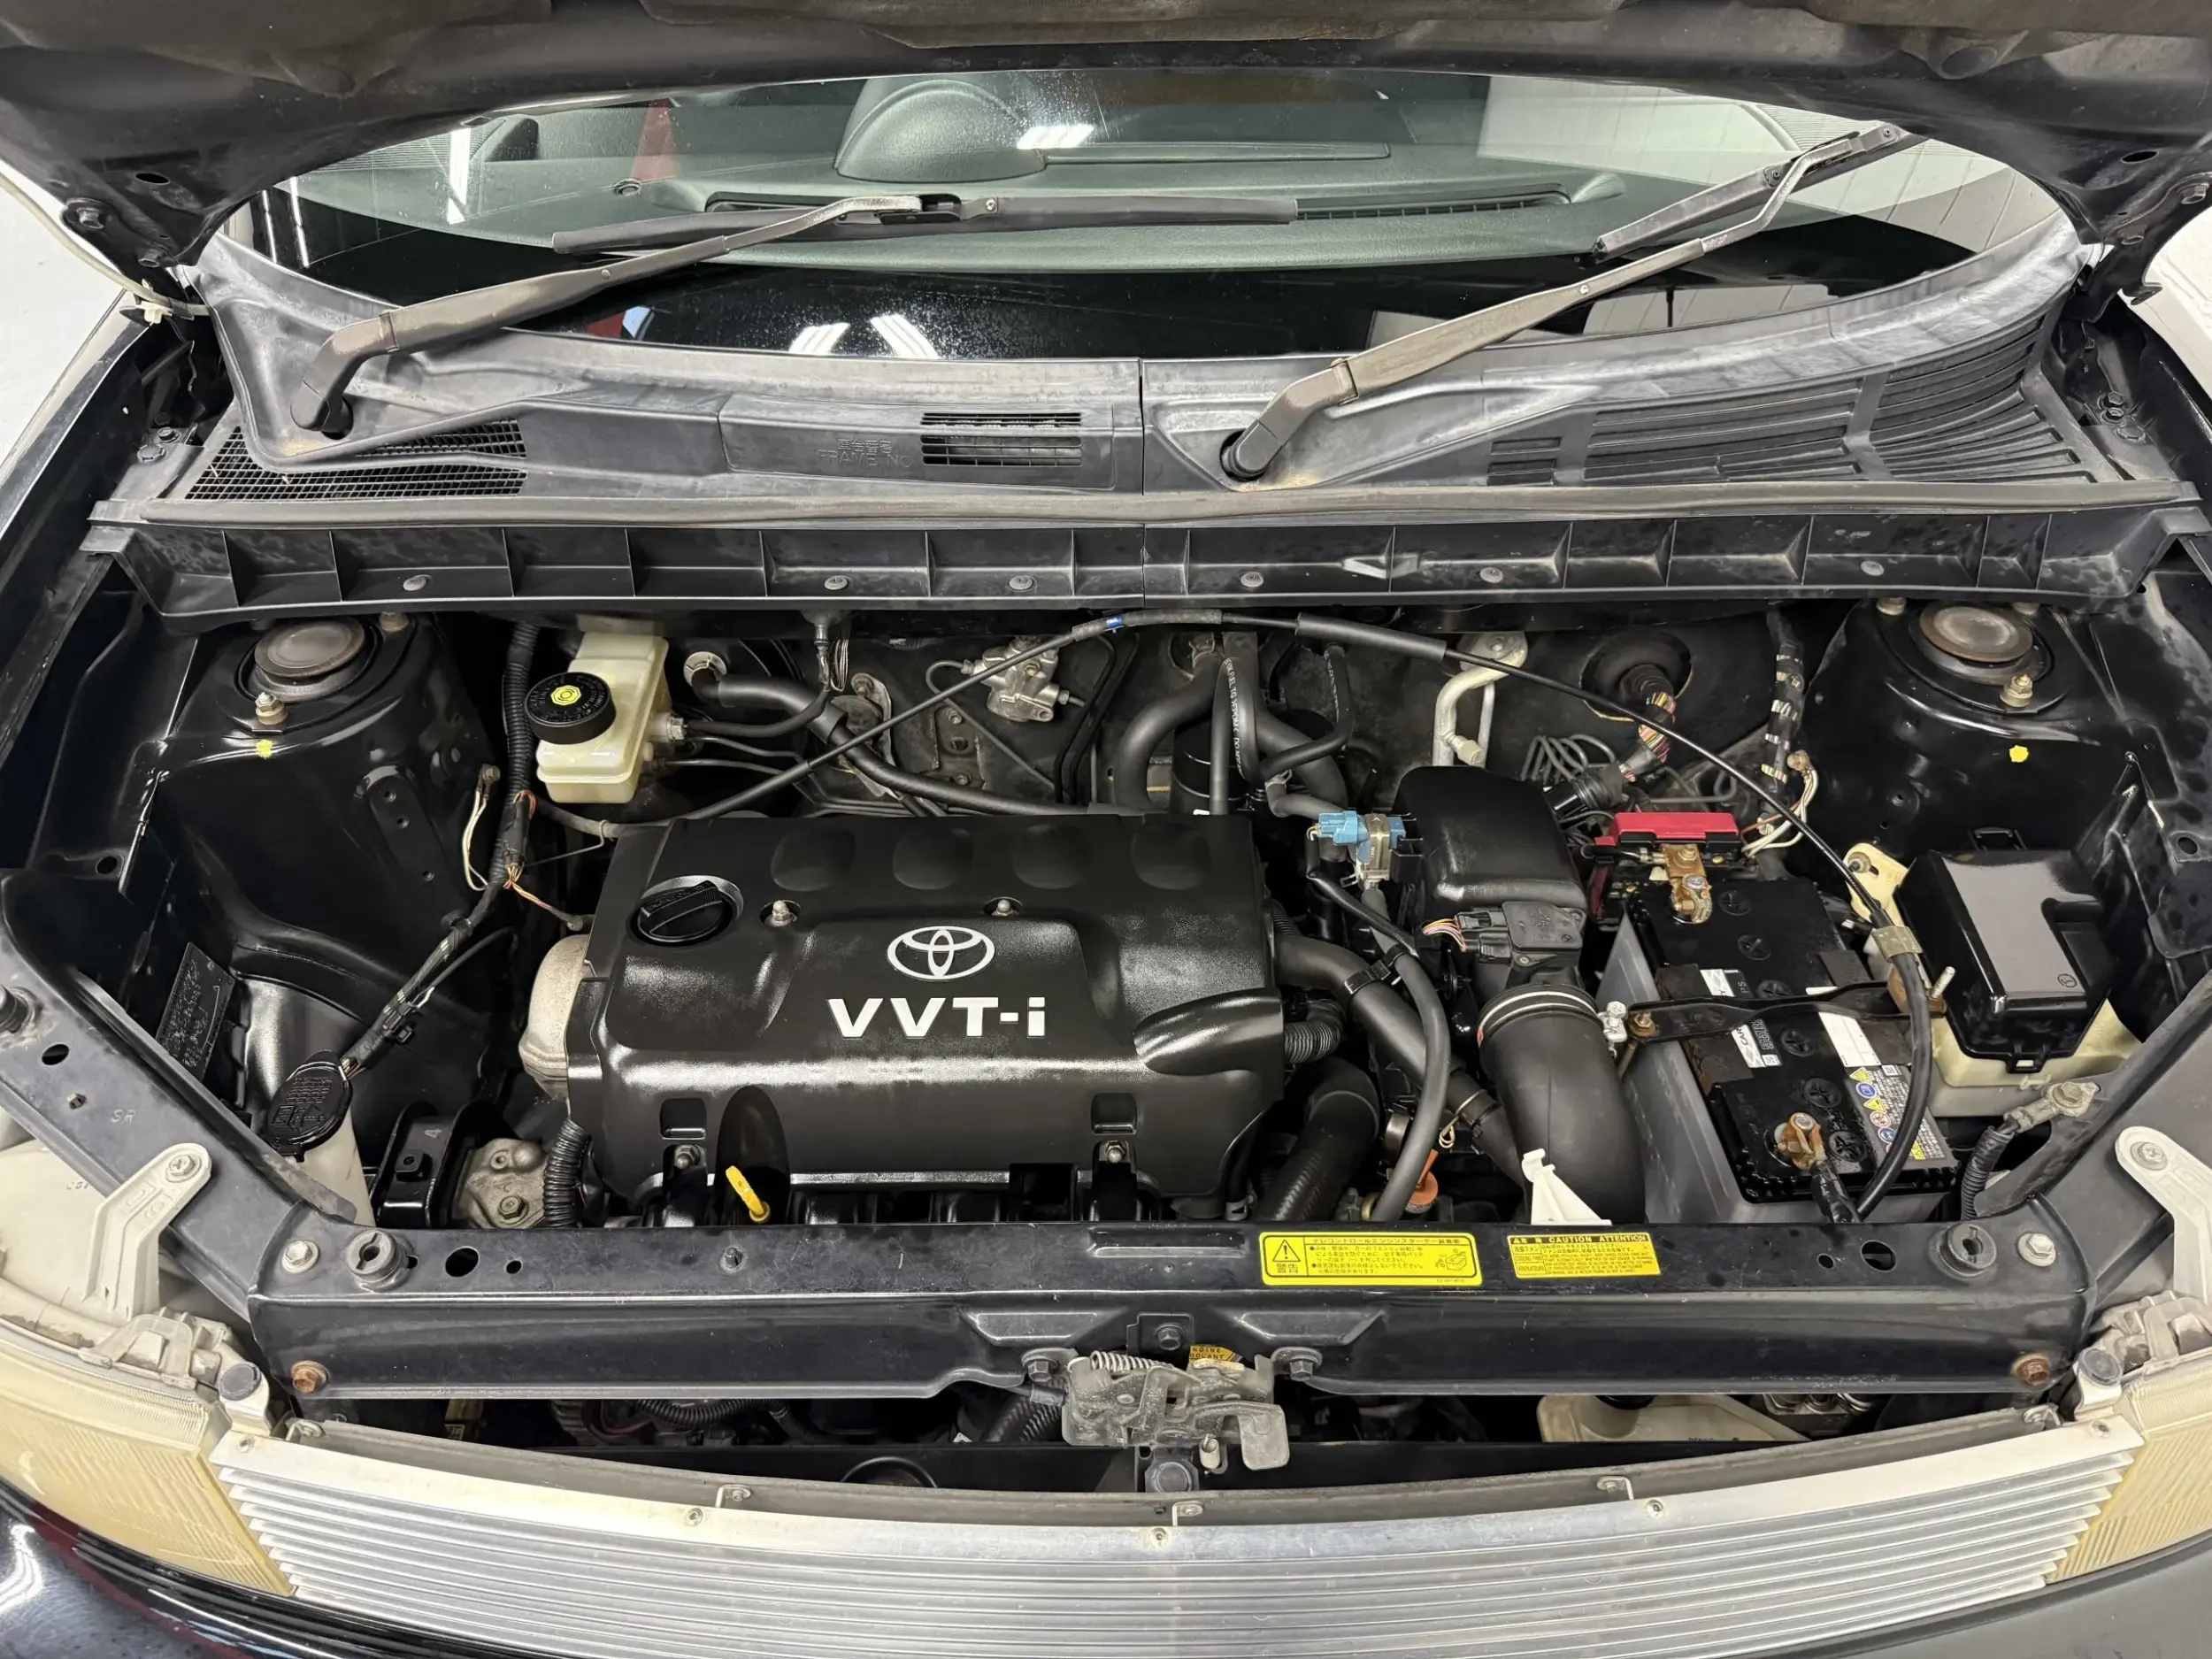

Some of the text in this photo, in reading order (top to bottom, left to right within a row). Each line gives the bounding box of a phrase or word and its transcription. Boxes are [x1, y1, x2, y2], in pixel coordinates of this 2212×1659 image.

[817, 449, 912, 468] FRAME NO
[827, 996, 1046, 1038] VVT-i
[1276, 1263, 1299, 1274] 警告
